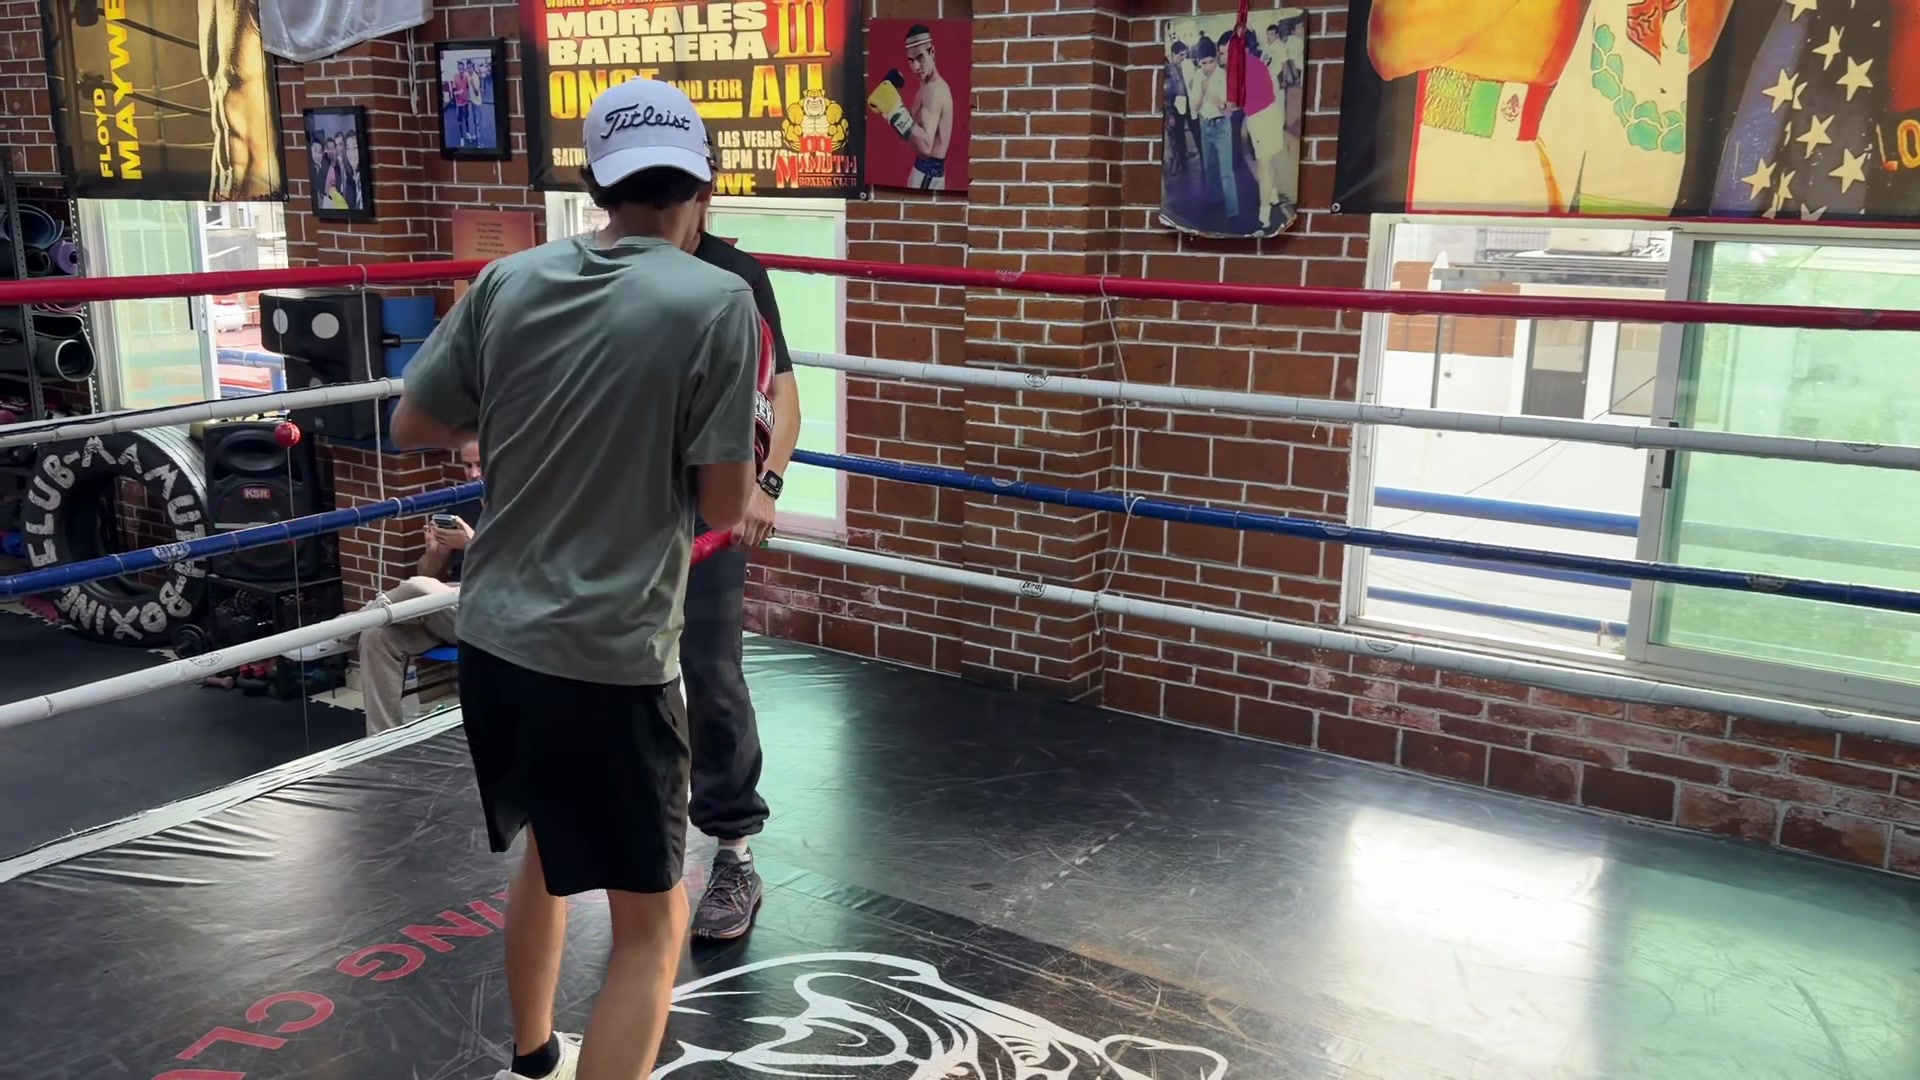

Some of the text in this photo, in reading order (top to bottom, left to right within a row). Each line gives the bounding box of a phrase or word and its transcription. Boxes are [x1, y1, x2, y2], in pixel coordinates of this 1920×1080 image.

[546, 0, 831, 58] MORALES III
[548, 31, 769, 66] BARRERA
[708, 79, 743, 99] FOR
[94, 88, 114, 178] FLOYD
[600, 103, 691, 140] Titleist
[717, 130, 782, 148] LAS VEGAS
[551, 147, 588, 167] SATU
[722, 148, 753, 169] 9PM
[715, 172, 756, 195] IVE
[798, 176, 857, 188] BOXING CLUB
